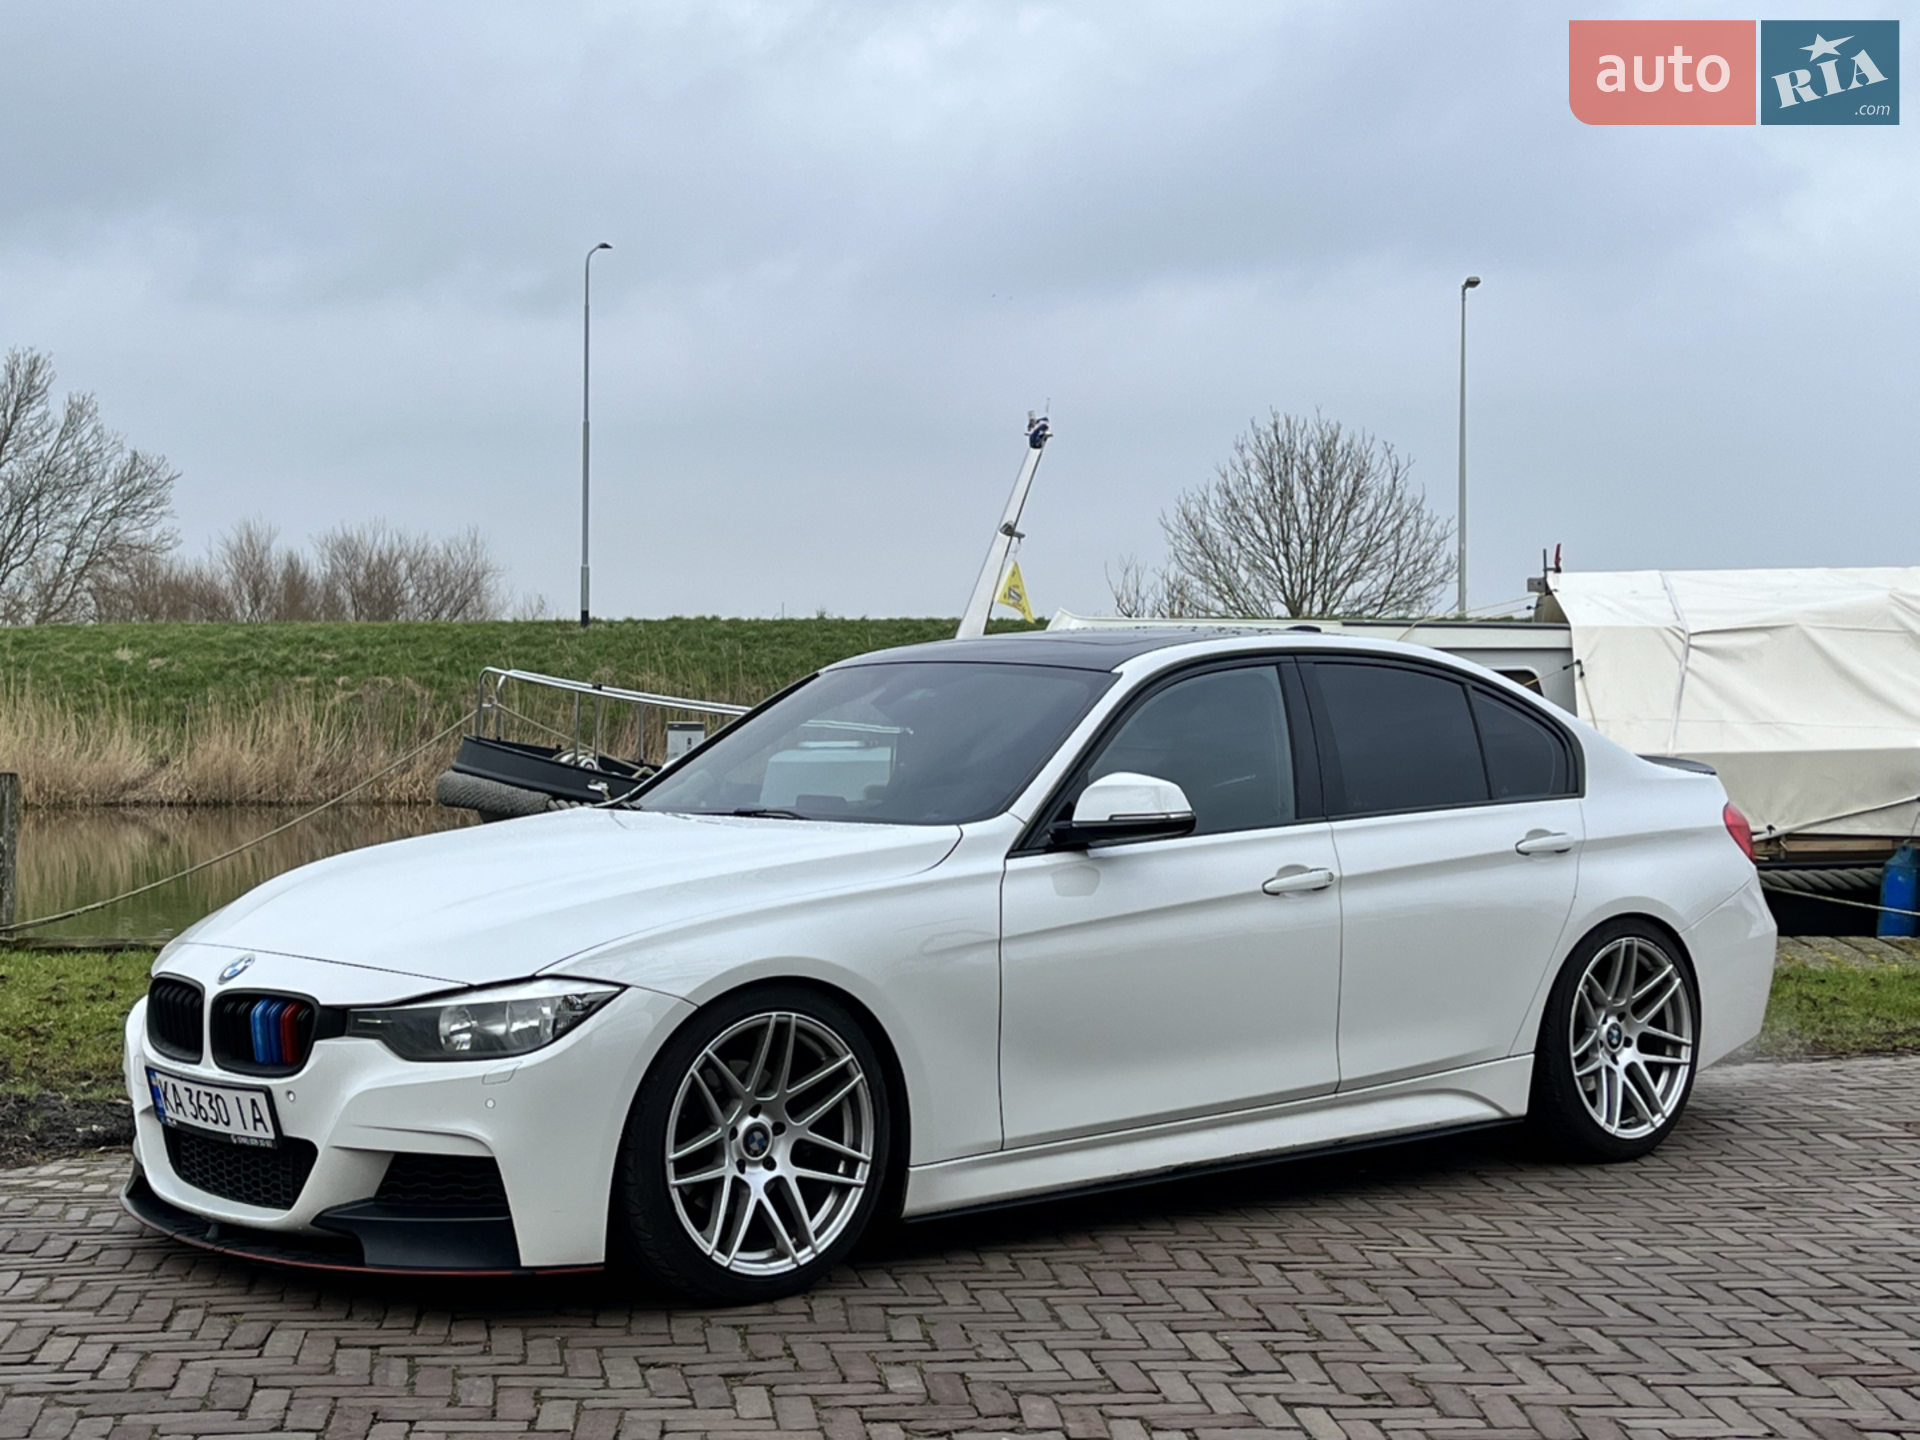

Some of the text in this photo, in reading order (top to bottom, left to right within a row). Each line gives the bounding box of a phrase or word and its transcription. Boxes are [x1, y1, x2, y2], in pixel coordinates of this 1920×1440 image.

[158, 1079, 269, 1133] KA 3630 IA
